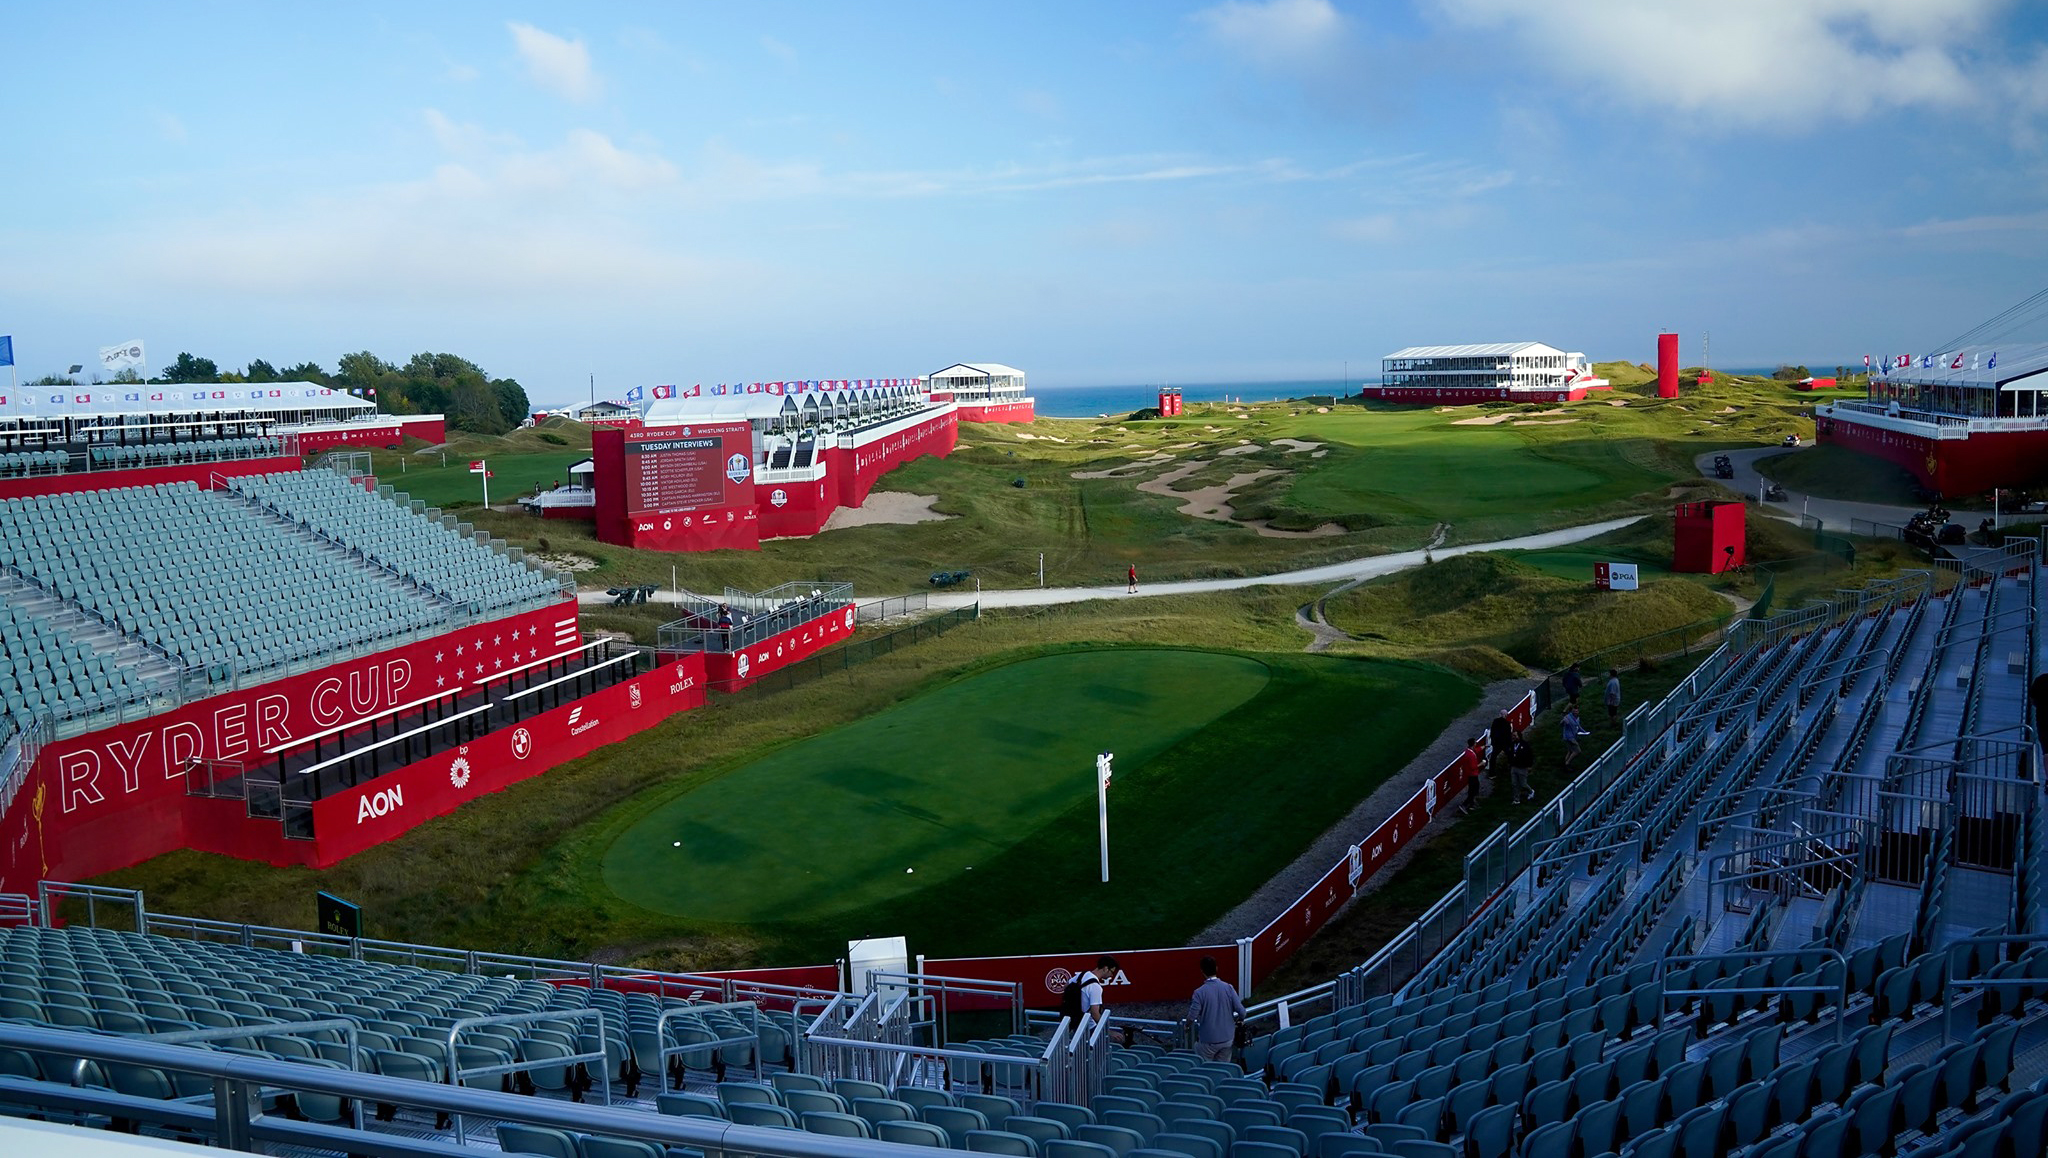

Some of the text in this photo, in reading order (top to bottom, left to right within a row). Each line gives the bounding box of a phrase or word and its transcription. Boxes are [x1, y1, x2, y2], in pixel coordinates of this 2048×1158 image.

[640, 440, 714, 451] TUESDAY INTERVIEWS
[638, 523, 654, 532] AON
[1600, 566, 1604, 575] 1
[758, 652, 769, 663] AON
[670, 676, 694, 695] ROLEX
[571, 719, 599, 736] Constellation
[59, 658, 412, 814] RYDER CUP
[460, 746, 468, 755] bp
[357, 784, 403, 824] AON
[1371, 842, 1382, 860] AON
[327, 921, 349, 937] ROLEX
